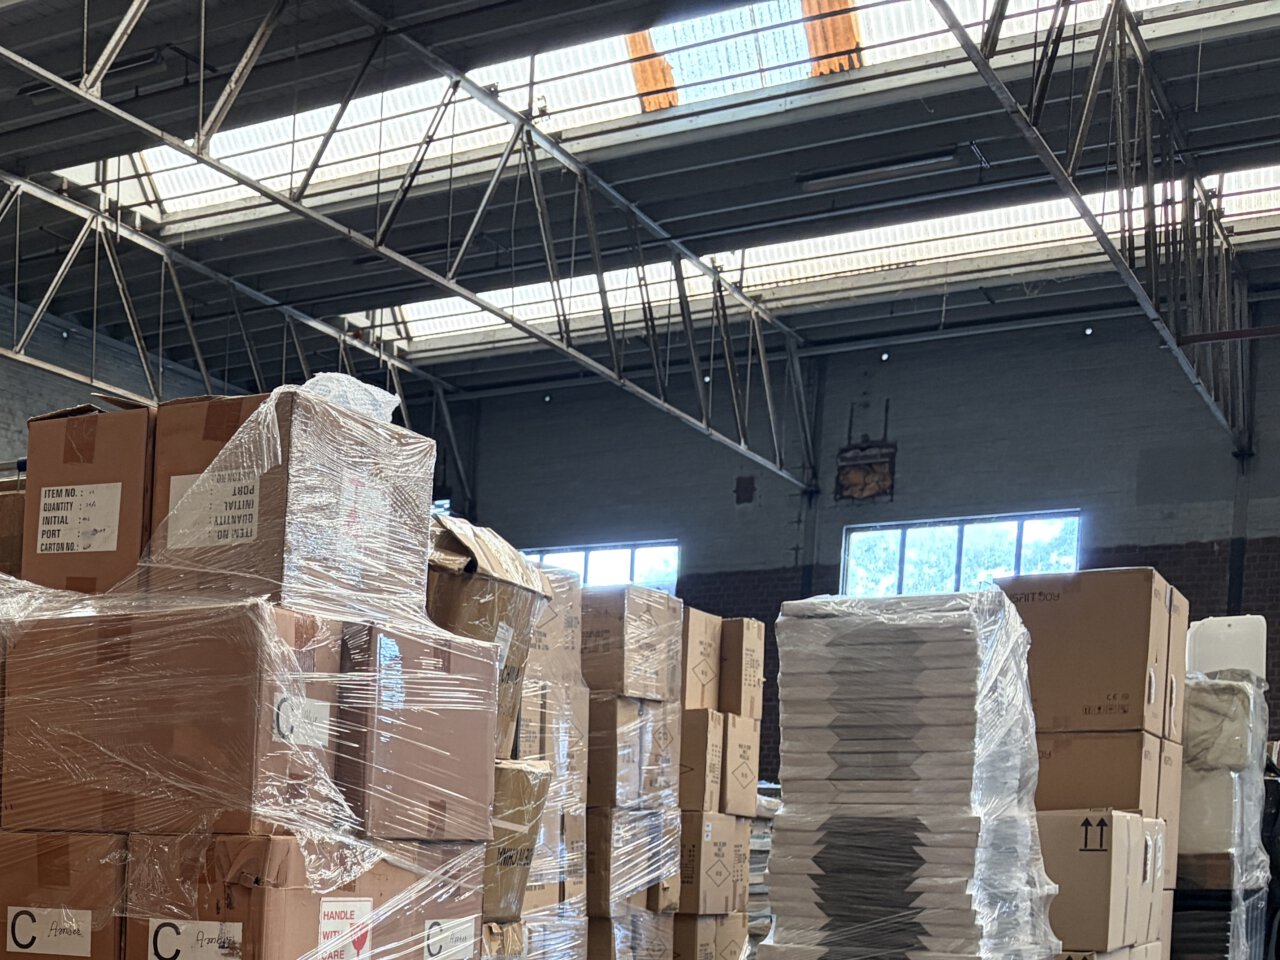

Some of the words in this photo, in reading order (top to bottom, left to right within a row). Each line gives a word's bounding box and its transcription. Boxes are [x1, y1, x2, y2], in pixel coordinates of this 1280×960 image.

[44, 489, 63, 499] ITEM
[65, 488, 78, 498] NO.
[232, 485, 255, 496] PORT
[43, 501, 74, 512] QUANTITY
[224, 500, 254, 511] INITIAL
[42, 515, 69, 525] INITIAL
[214, 513, 254, 526] QUANTITY
[41, 529, 61, 539] PORT
[41, 542, 65, 552] CARTON
[66, 542, 76, 551] NO.
[323, 911, 355, 920] HANDLE
[11, 910, 37, 950] C
[427, 921, 443, 958] C
[322, 950, 345, 960] CARE
